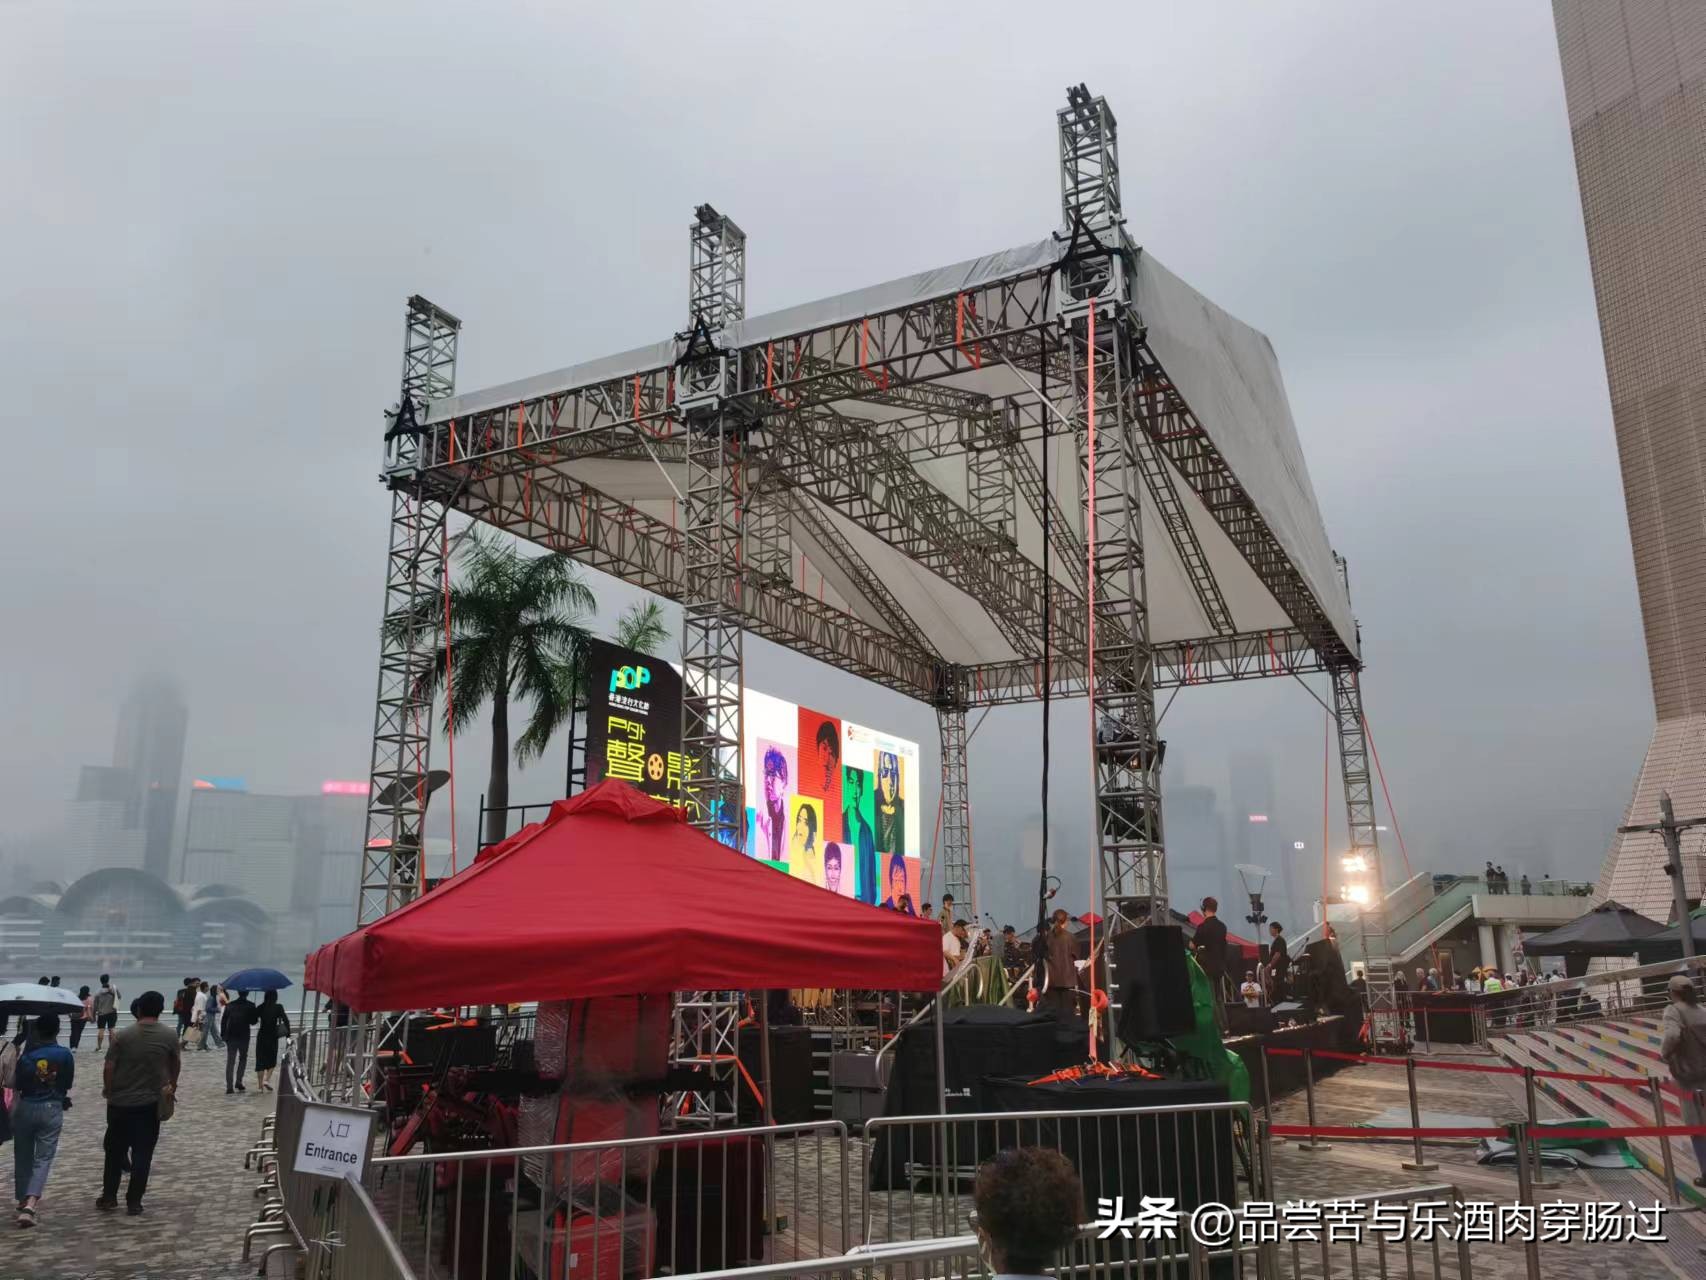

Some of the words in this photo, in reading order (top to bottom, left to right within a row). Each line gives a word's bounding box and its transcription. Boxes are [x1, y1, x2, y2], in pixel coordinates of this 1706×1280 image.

[609, 665, 651, 692] POP
[322, 1119, 351, 1138] 入口
[304, 1142, 358, 1165] Entrance
